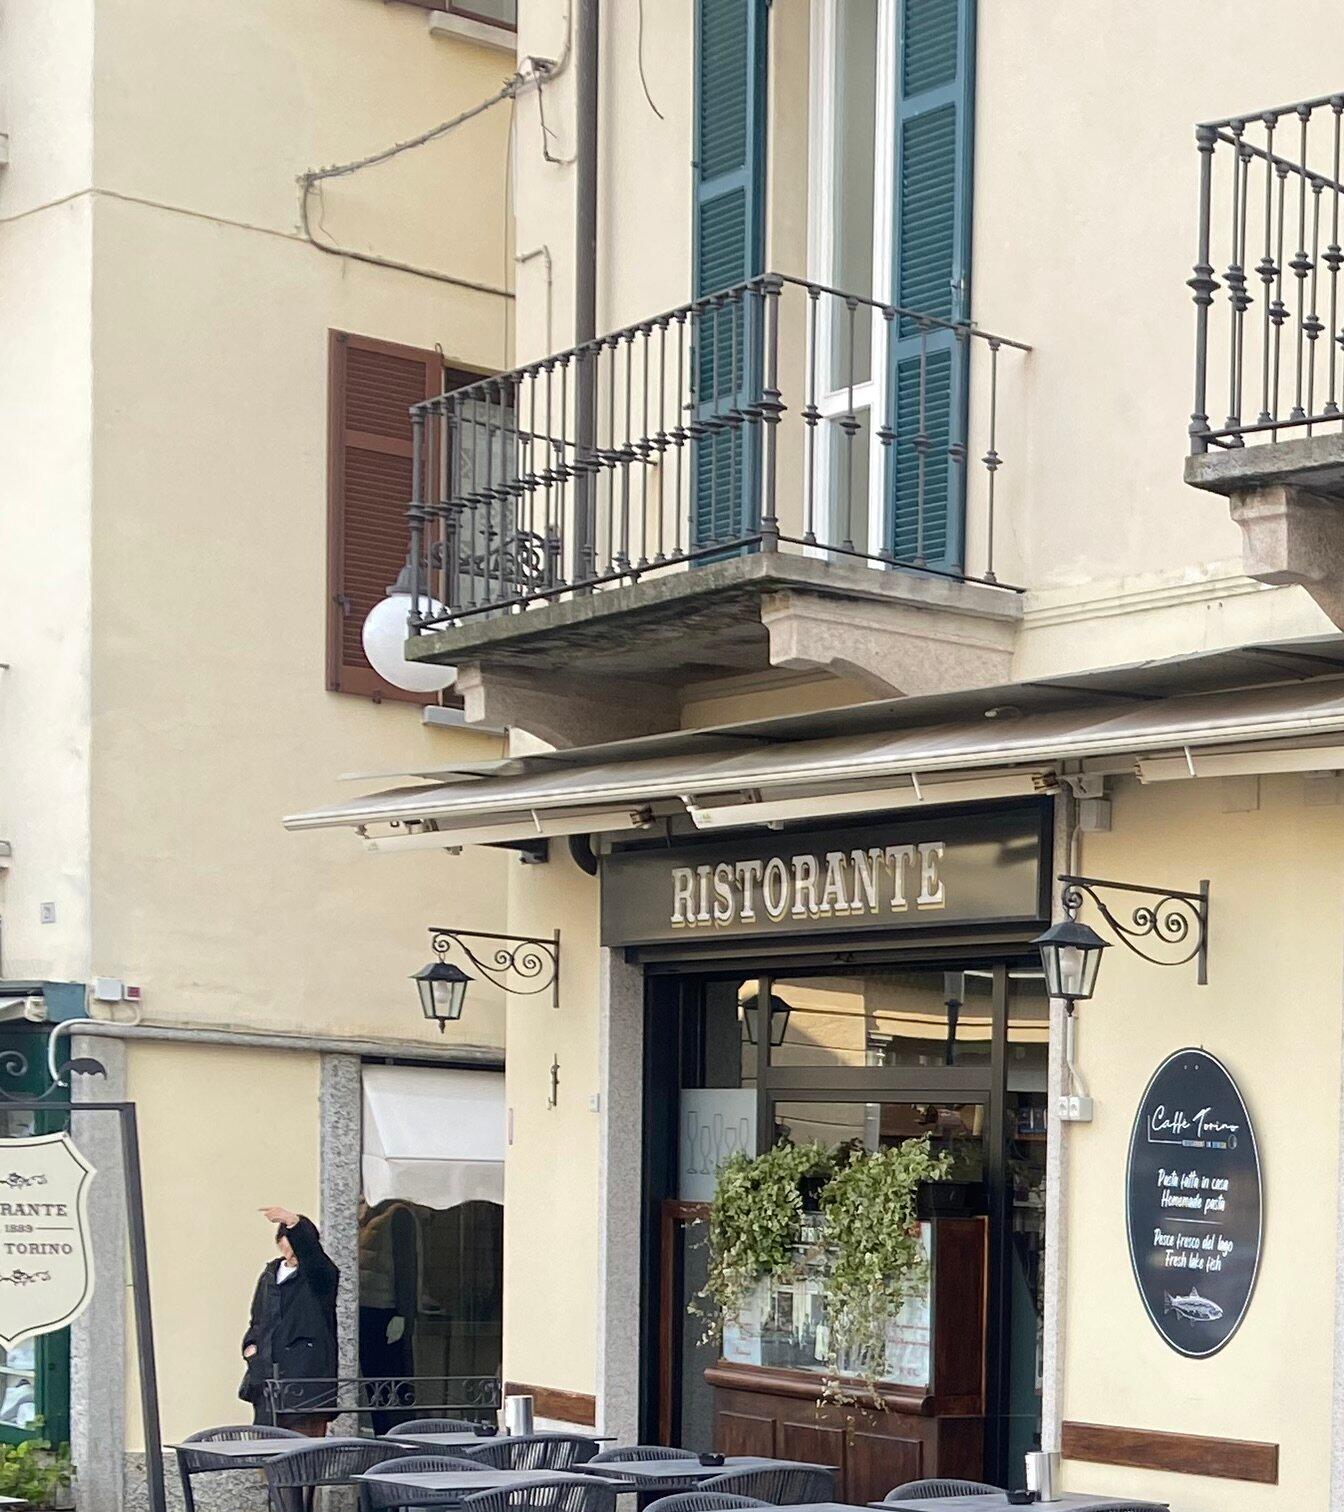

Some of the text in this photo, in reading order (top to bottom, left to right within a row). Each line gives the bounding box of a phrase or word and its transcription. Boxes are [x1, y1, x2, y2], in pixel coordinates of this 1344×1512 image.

[670, 841, 946, 930] RISTORANTE
[1193, 1107, 1239, 1138] Torino
[1157, 1168, 1180, 1188] Pasta
[1202, 1174, 1210, 1188] in
[1211, 1177, 1229, 1191] casa
[1161, 1188, 1226, 1215] Homemade pasta
[4, 1243, 73, 1254] TORINO
[1153, 1228, 1234, 1257] Pesce fresco del lago
[1165, 1249, 1222, 1273] Fresh lake fish
